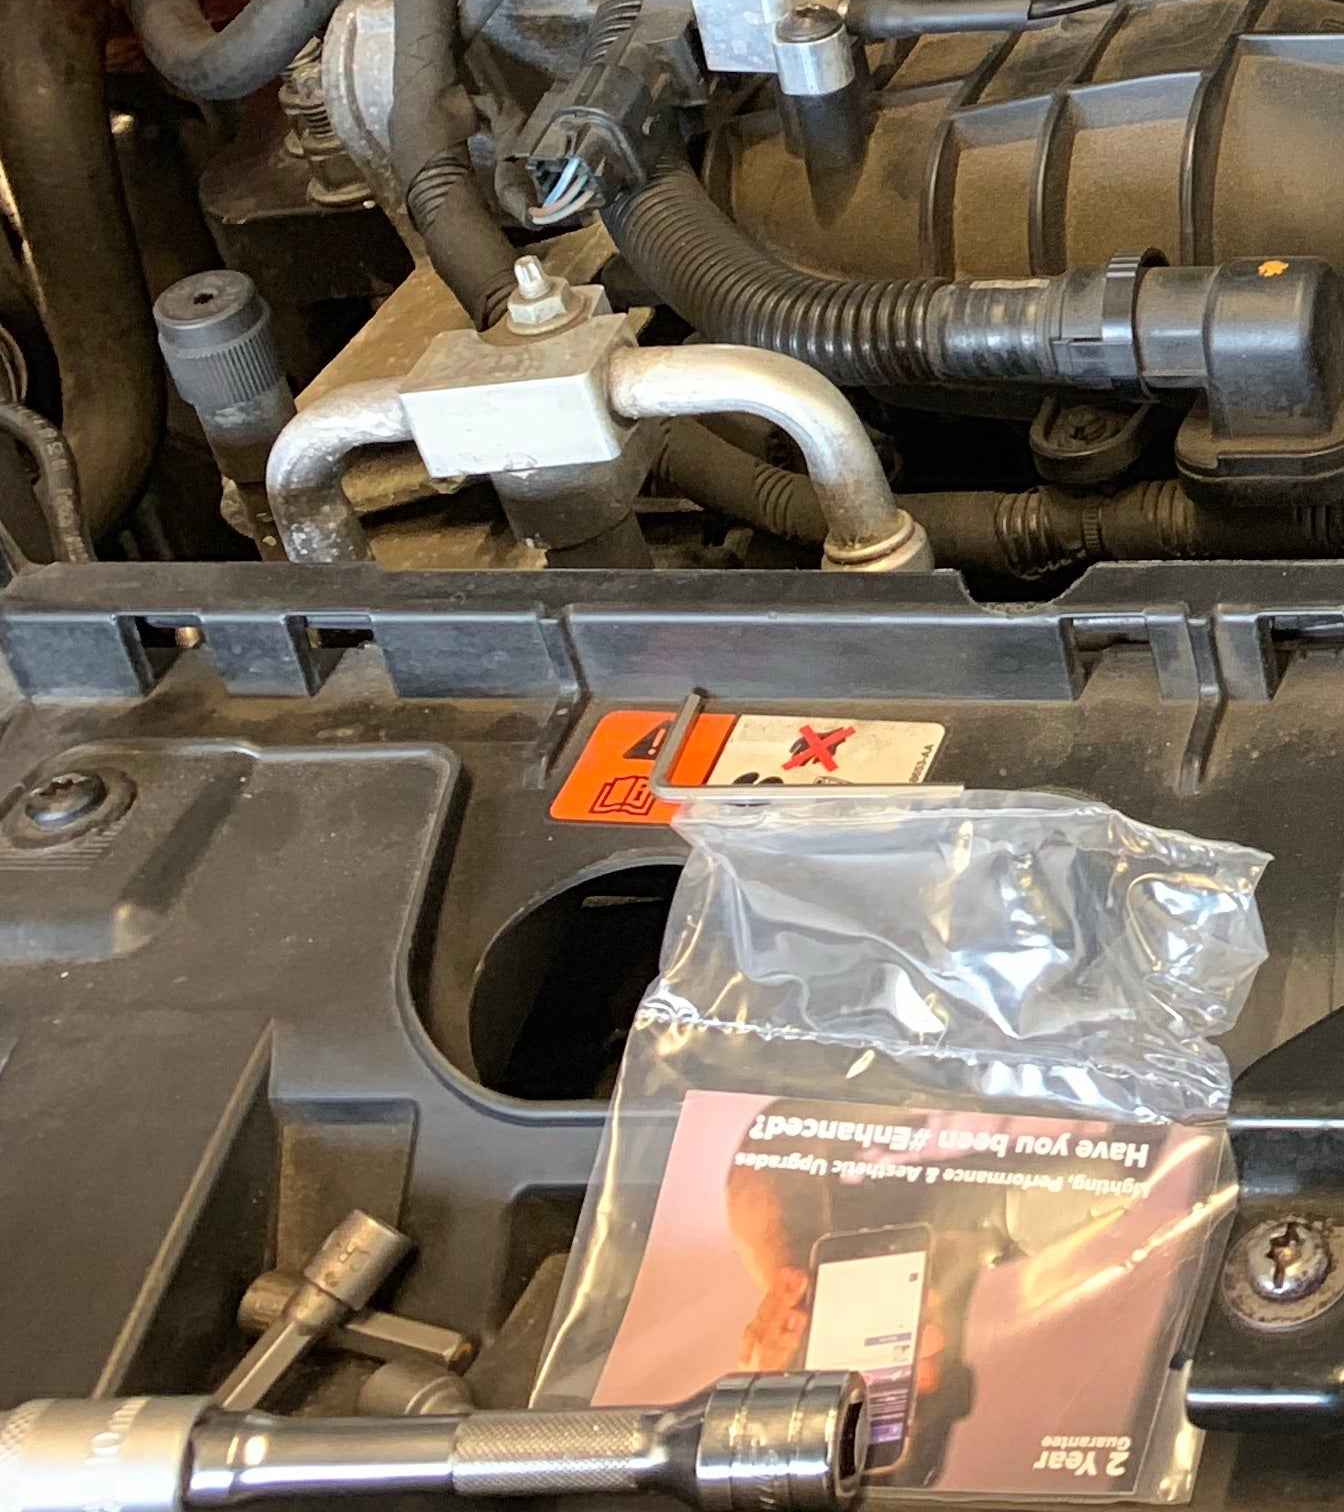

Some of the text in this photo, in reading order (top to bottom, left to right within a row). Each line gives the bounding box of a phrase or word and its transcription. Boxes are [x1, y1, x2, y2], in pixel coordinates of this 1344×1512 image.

[748, 1114, 1150, 1169] Have you been #Enhanced?
[734, 1151, 829, 1176] Upgrades
[831, 1159, 923, 1183] Aesthetic
[925, 1165, 941, 1184] &
[943, 1167, 1065, 1192] Performance
[1040, 1434, 1132, 1451] Guarantee
[1031, 1449, 1131, 1477] 2 Year
